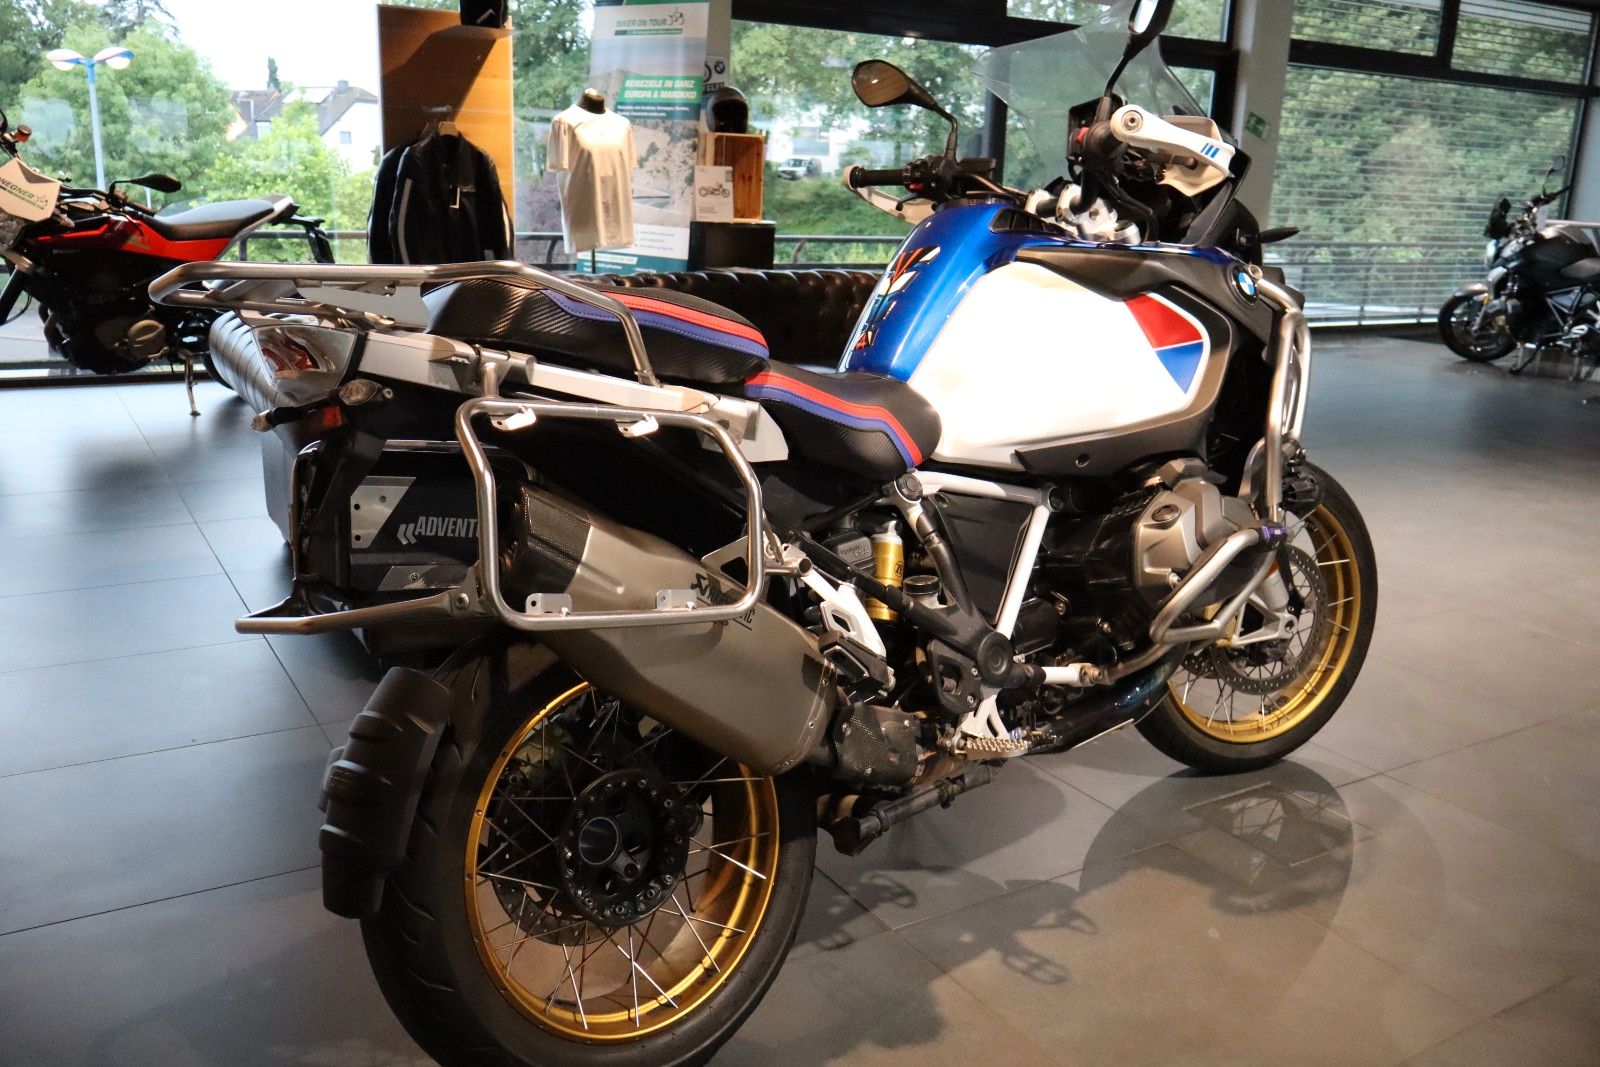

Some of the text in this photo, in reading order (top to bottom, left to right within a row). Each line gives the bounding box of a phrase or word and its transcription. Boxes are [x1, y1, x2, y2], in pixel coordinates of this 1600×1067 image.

[637, 19, 648, 27] ON
[649, 18, 667, 27] TOUR
[664, 79, 673, 88] IN
[624, 90, 651, 98] EUROPA
